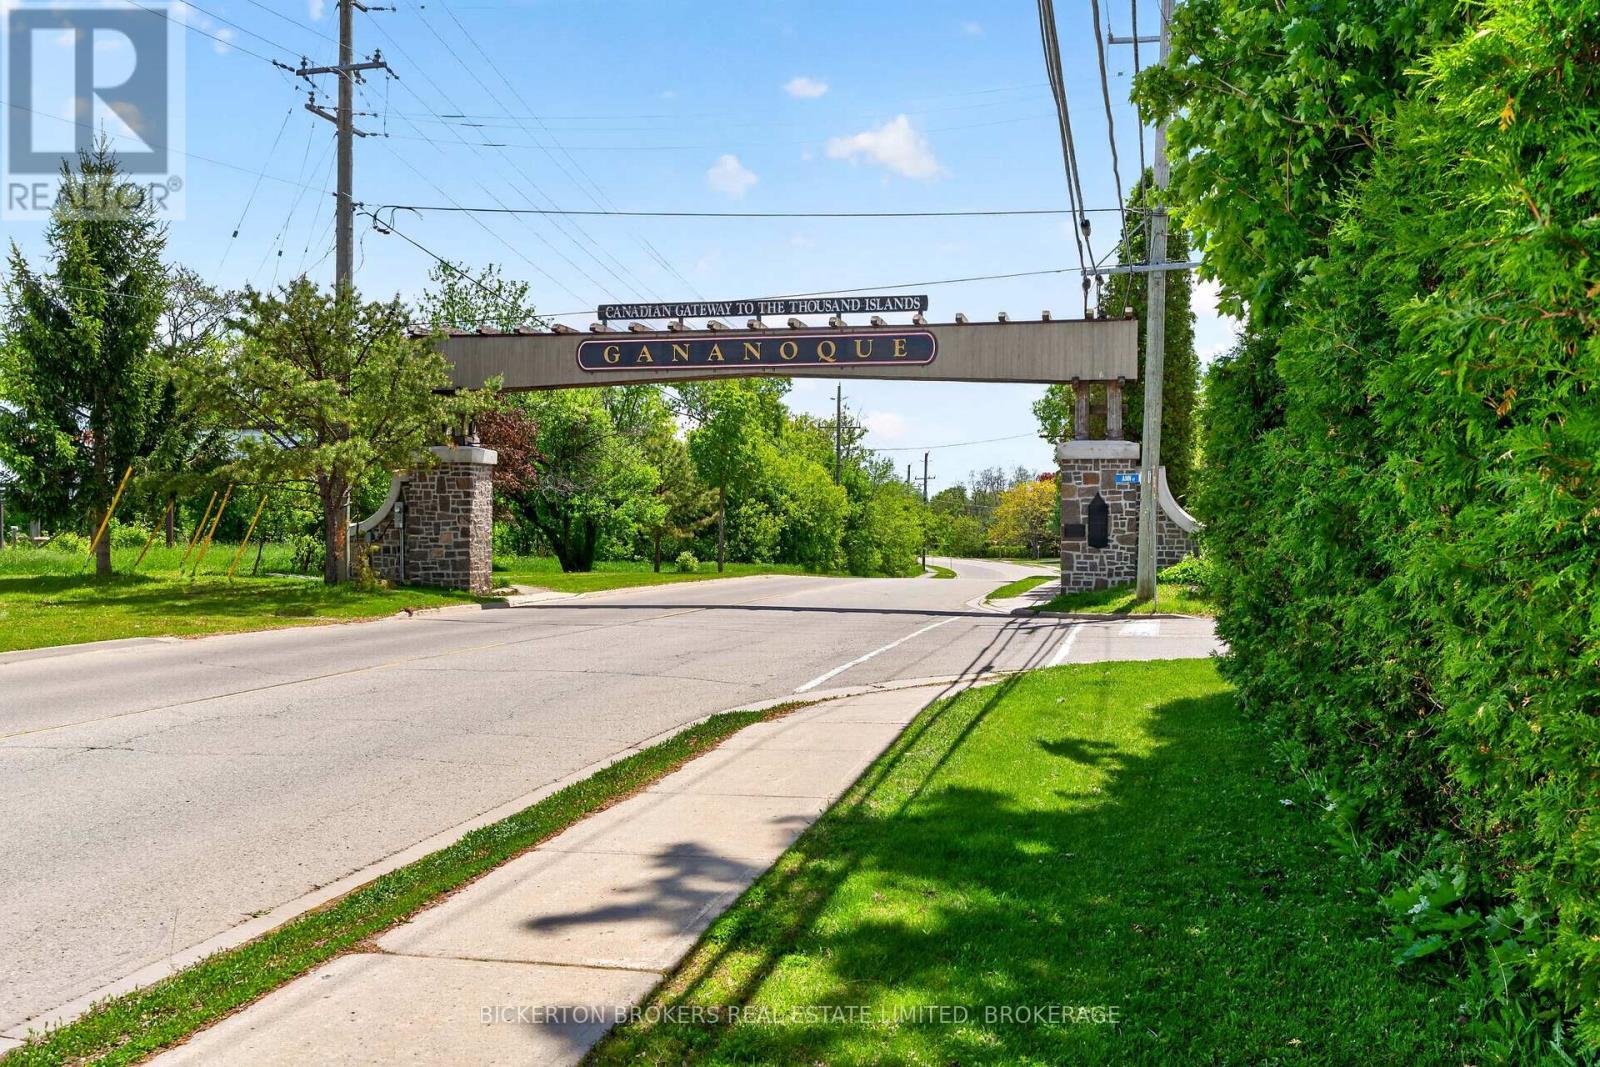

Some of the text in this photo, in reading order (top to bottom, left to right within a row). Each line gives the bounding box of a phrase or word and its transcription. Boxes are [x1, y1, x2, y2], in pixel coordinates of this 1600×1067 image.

[605, 297, 921, 319] CANADIAN GATEWAY TO THE THOUSAND ISLANDS
[603, 338, 909, 363] GANANOQUE
